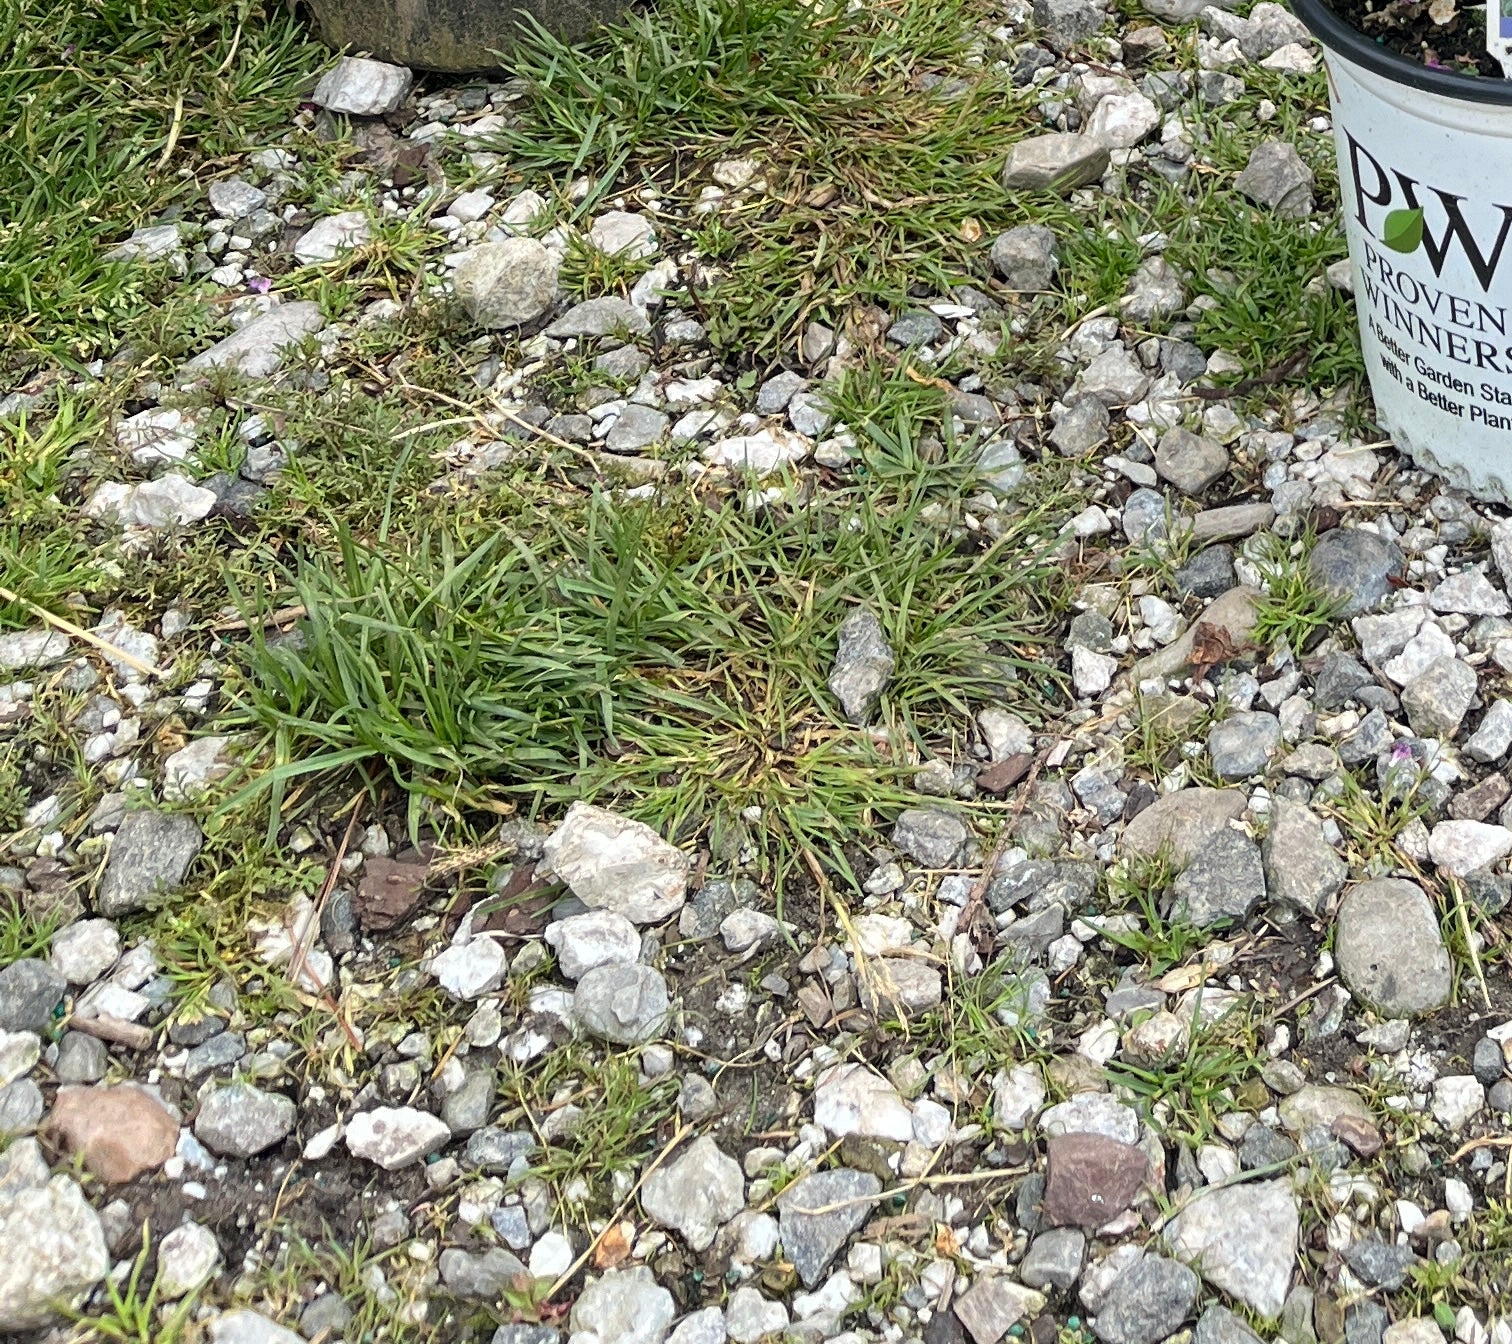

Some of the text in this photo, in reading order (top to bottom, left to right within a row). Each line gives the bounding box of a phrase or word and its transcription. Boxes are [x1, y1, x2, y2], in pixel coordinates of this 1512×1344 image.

[1363, 239, 1508, 337] PROVEN
[1368, 313, 1376, 336] A
[1376, 324, 1411, 366] Better
[1414, 355, 1475, 397] Garden
[1380, 352, 1403, 385] with
[1405, 376, 1415, 394] a
[1417, 380, 1466, 418] Better
